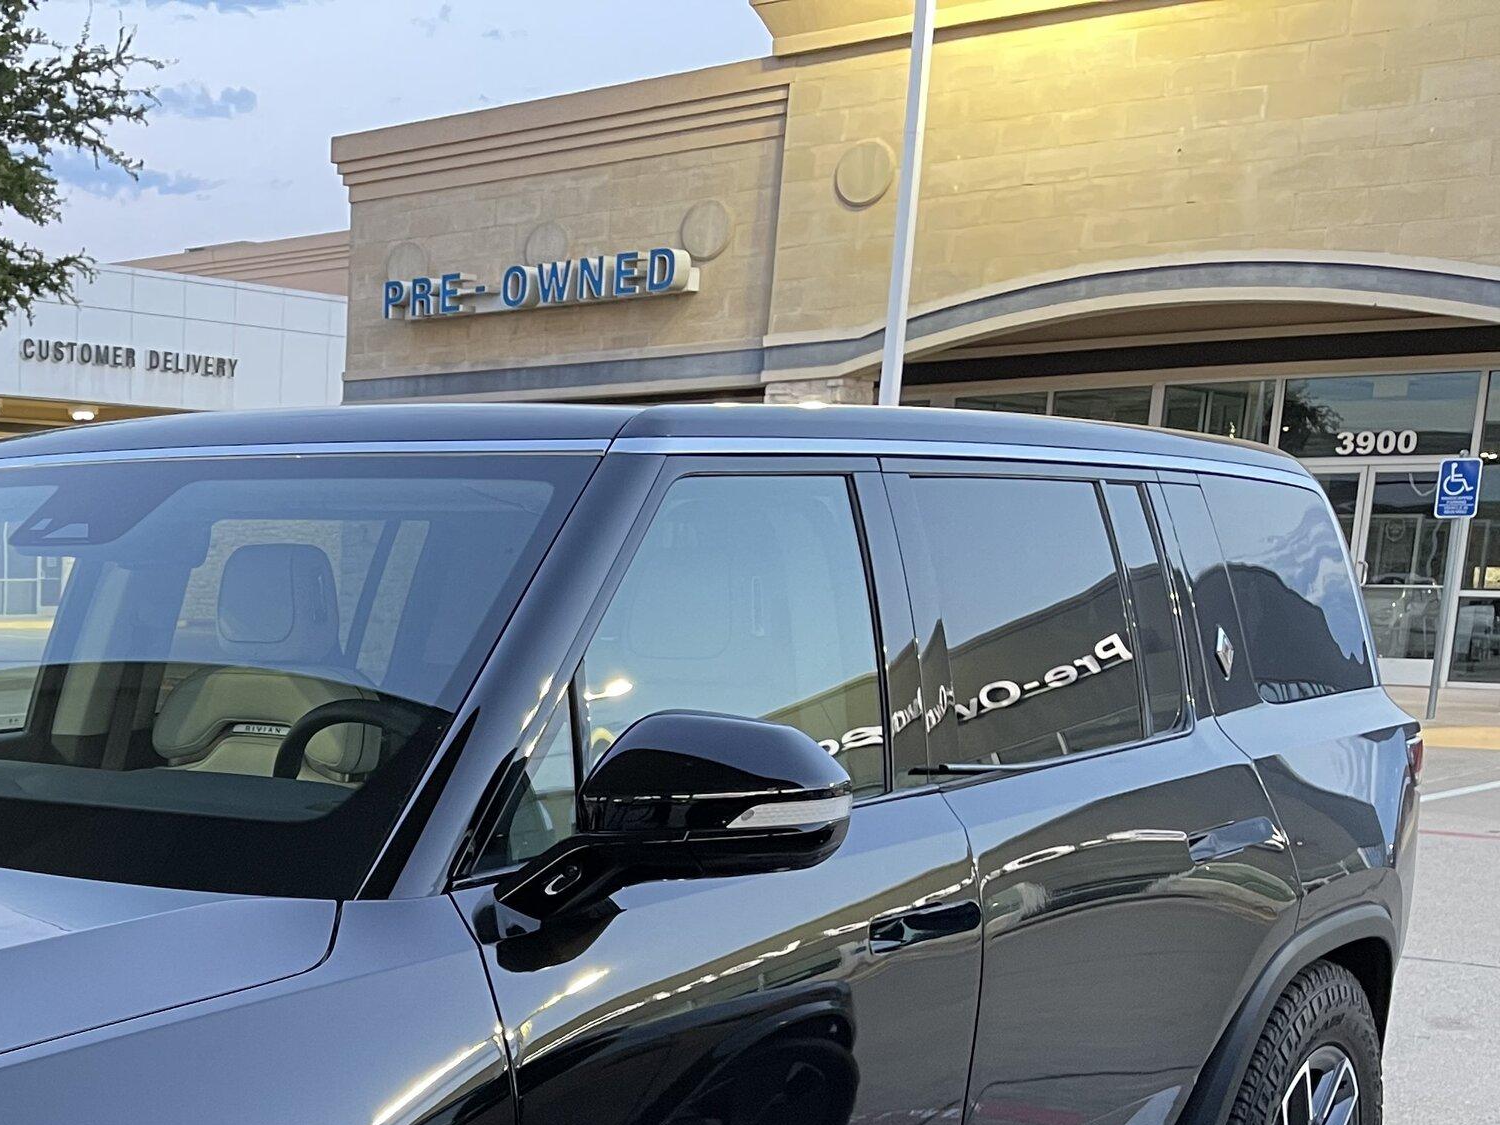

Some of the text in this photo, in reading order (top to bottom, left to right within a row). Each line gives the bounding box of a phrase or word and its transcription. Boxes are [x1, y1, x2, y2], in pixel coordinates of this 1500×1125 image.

[21, 338, 238, 379] CUSTOMER DELIVERY
[1335, 430, 1418, 455] 3900
[245, 725, 282, 734] RIVIAN
